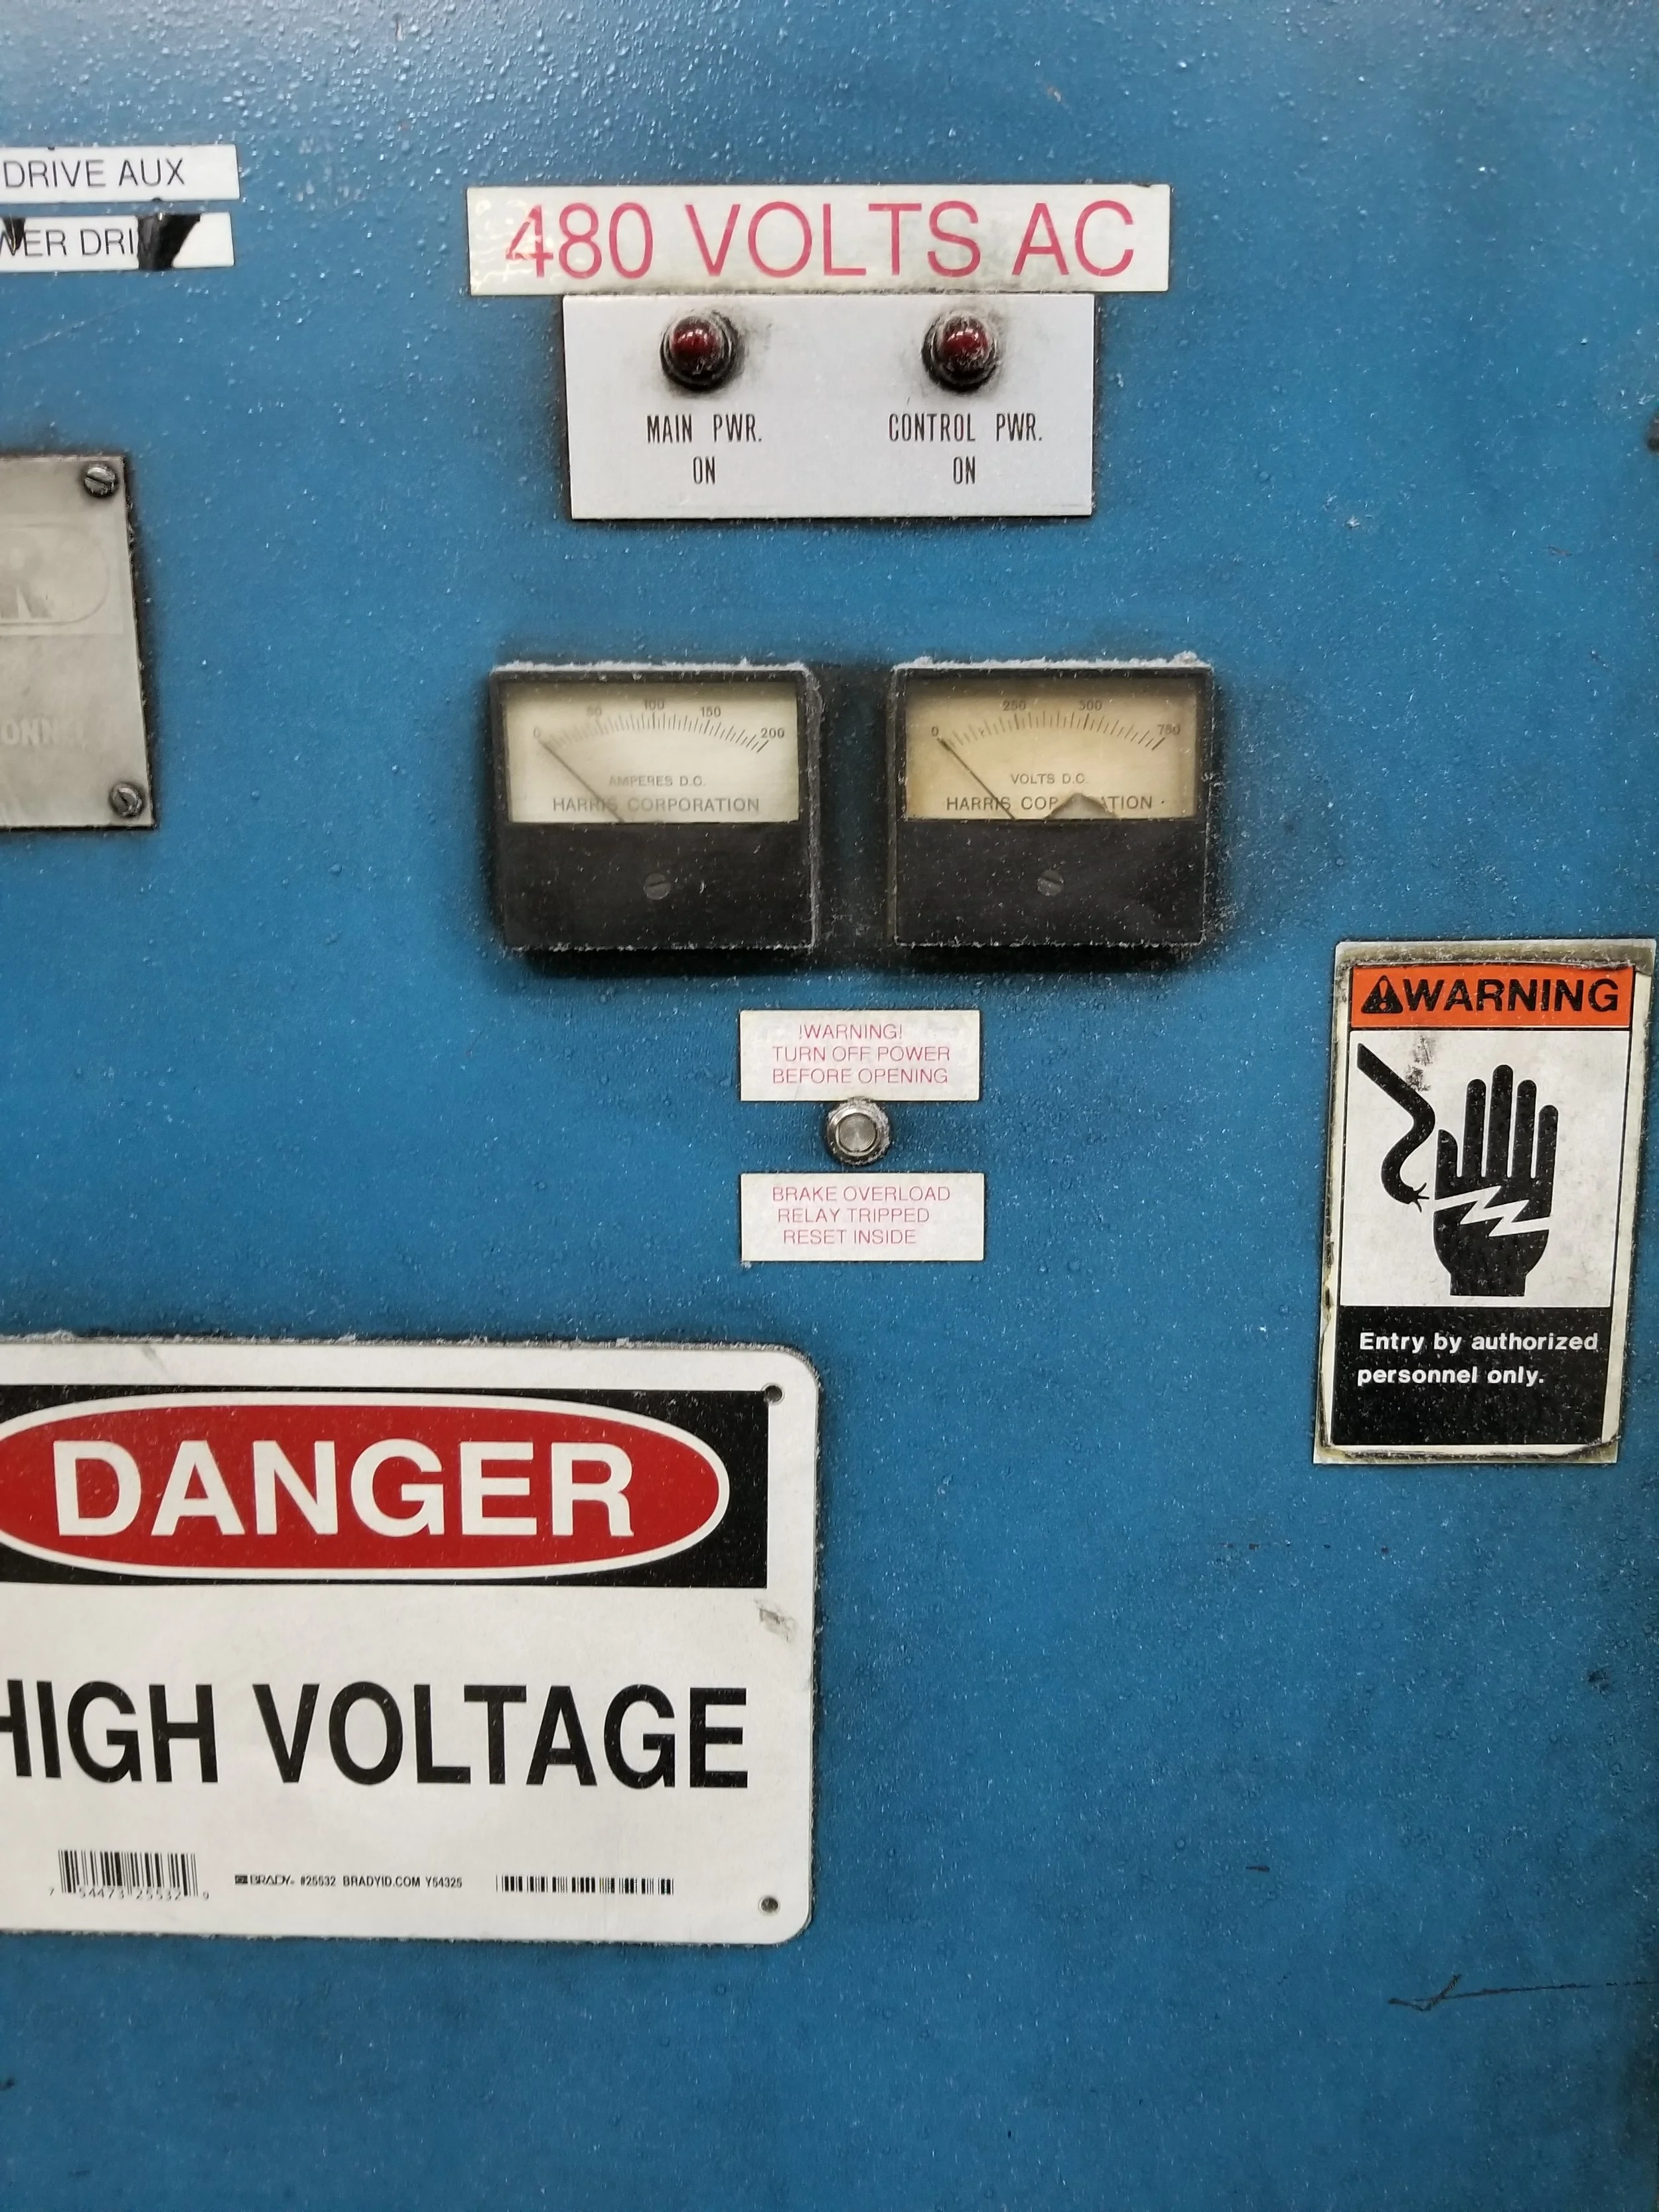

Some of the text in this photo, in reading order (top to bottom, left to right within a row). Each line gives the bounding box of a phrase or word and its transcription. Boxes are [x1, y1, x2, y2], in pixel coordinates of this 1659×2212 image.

[3, 157, 185, 188] DRIVE AUX
[80, 228, 135, 256] DRI
[504, 199, 1135, 280] 480 VOLTS AC
[646, 413, 762, 443] MAIN PWR.
[888, 411, 1043, 443] CONTROL PWR.
[692, 455, 716, 485] ON
[952, 455, 975, 484] ON
[644, 699, 664, 711] 100
[700, 705, 721, 717] 150
[1003, 700, 1027, 711] 250
[760, 727, 785, 739] 200
[930, 725, 940, 737] 0
[609, 774, 673, 787] AMPERES
[1010, 773, 1055, 785] VOLTS
[552, 796, 760, 813] HARRIS CORPORATION
[946, 796, 1011, 812] HARRIS
[1402, 976, 1619, 1013] WARNING
[798, 1023, 903, 1040] !WARNING!
[772, 1045, 950, 1062] TURN OFF POWER
[772, 1067, 948, 1084] BEFORE OPENING
[772, 1185, 951, 1202] BRAKE OVERLOAD
[777, 1207, 930, 1224] RELAY TRIPPED
[782, 1229, 916, 1245] RESET INSIDE
[1359, 1331, 1599, 1354] Entry by authorized
[1356, 1365, 1545, 1387] personnel only.
[51, 1438, 634, 1538] DANGER
[252, 1682, 749, 1791] VOLTAGE
[342, 1875, 421, 1888] BRADYID.COM
